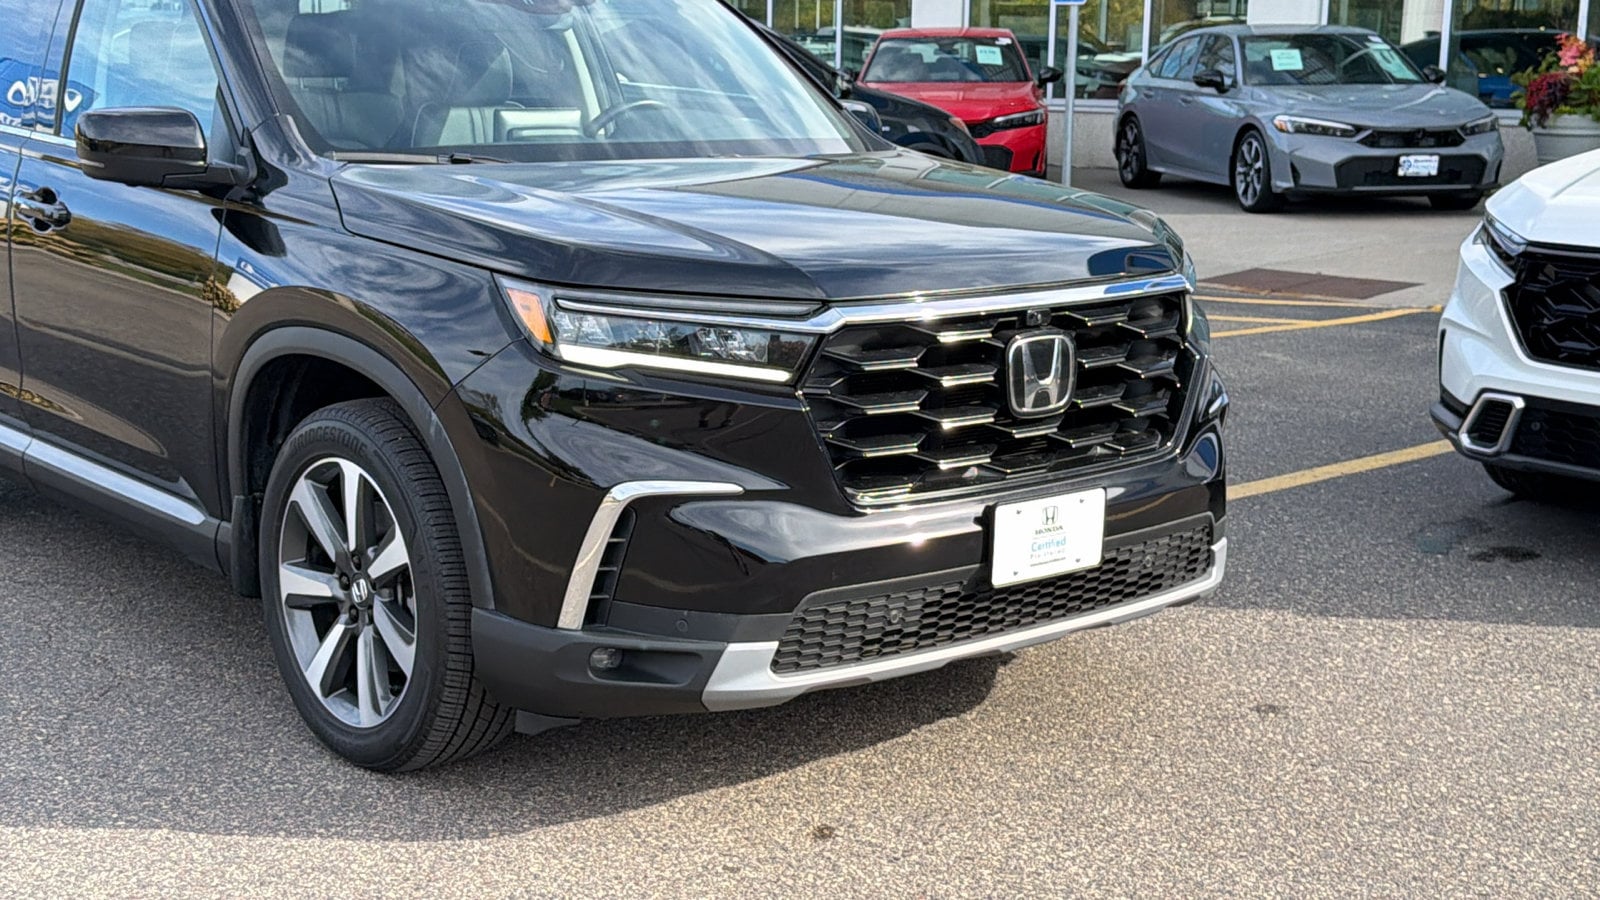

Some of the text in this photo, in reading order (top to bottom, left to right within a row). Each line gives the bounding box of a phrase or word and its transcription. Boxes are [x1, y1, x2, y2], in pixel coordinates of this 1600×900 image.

[289, 425, 368, 457] BRIDGESTONE
[1034, 525, 1064, 535] HONDA
[1031, 536, 1067, 552] Certified
